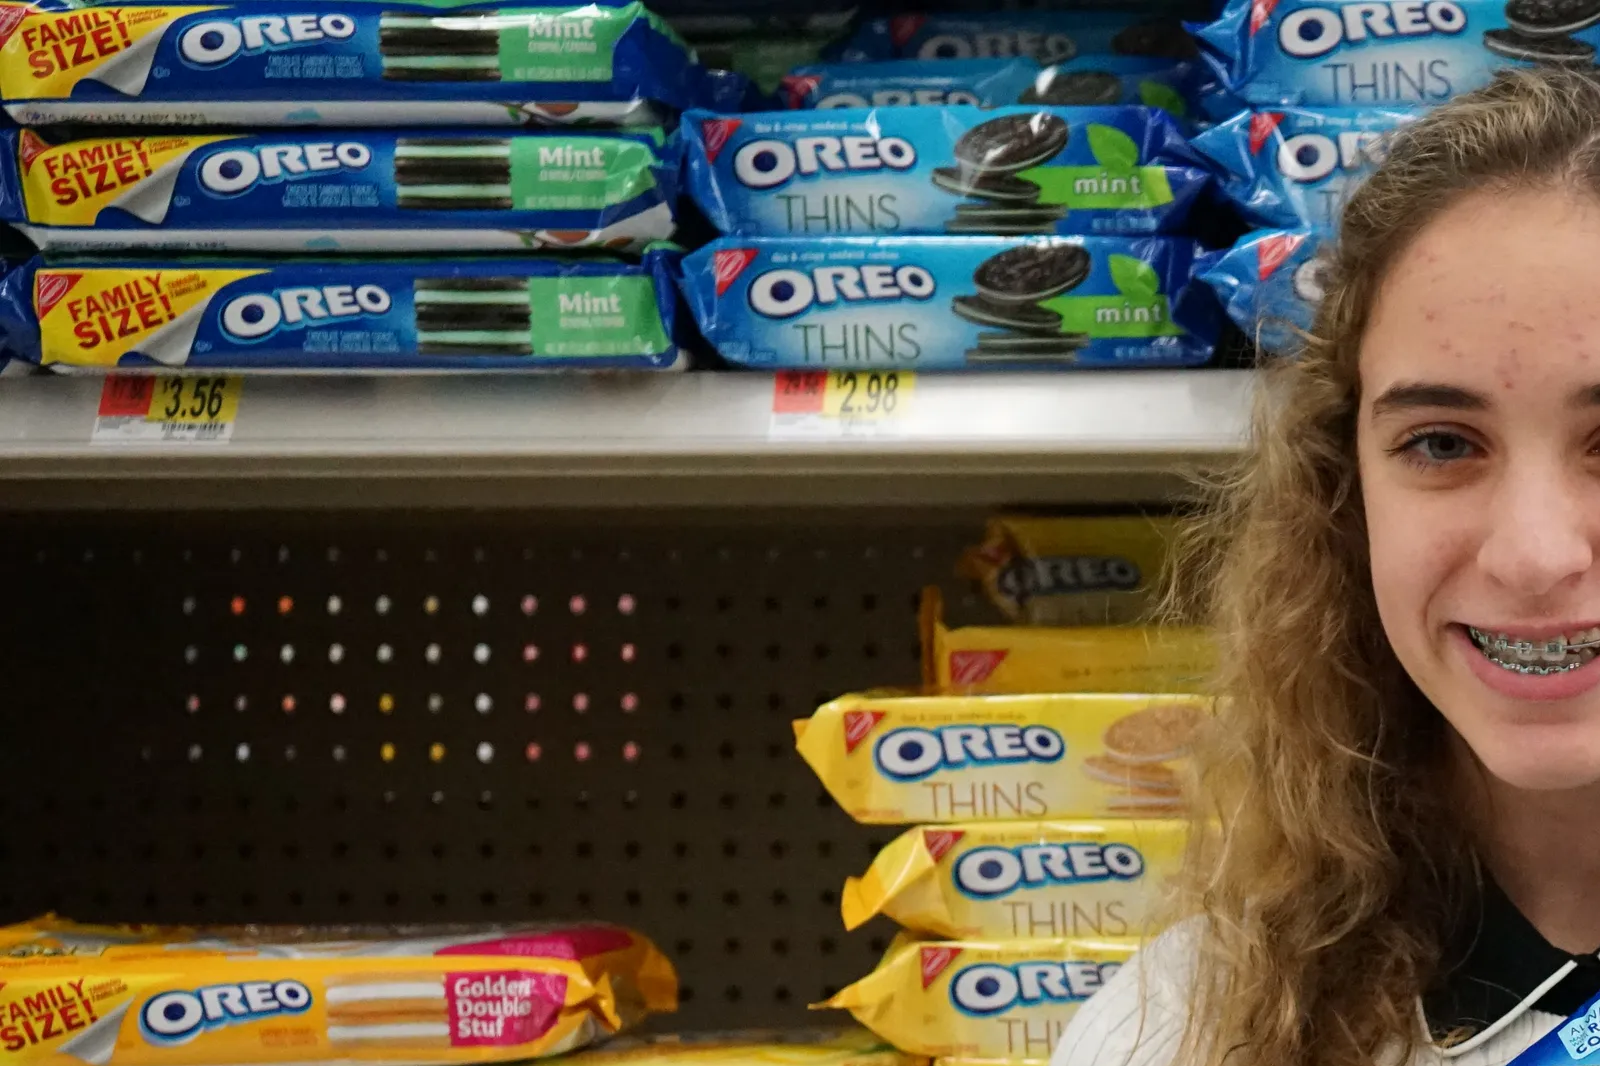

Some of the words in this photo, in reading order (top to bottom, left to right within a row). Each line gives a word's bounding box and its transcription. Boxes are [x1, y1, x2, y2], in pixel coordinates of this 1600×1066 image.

[23, 8, 125, 50] FAMILY
[181, 14, 356, 62] OREO
[528, 16, 594, 39] Mint
[1280, 2, 1465, 55] OREO
[29, 25, 133, 77] SIZE!
[1323, 59, 1452, 100] THINS
[43, 139, 146, 180] FAMILY
[202, 143, 371, 193] OREO
[539, 146, 605, 168] Mint
[735, 137, 915, 187] OREO
[52, 152, 153, 205] SIZE!
[1074, 174, 1140, 195] mint
[777, 194, 900, 232] THINS
[67, 274, 164, 322] FAMILY
[223, 284, 391, 338] OREO
[559, 292, 620, 314] Mint
[750, 266, 935, 316] OREO
[74, 295, 175, 349] SIZE!
[1096, 302, 1160, 324] mint
[799, 324, 921, 362] THINS
[879, 726, 1064, 777] OREO
[923, 783, 1048, 817] THINS
[955, 844, 1142, 896] OREO
[1002, 902, 1128, 937] THINS
[143, 980, 312, 1034] OREO
[455, 977, 530, 996] Golden
[3, 1001, 97, 1049] SIZE!
[457, 999, 531, 1018] Double
[457, 1017, 502, 1037] Stuf
